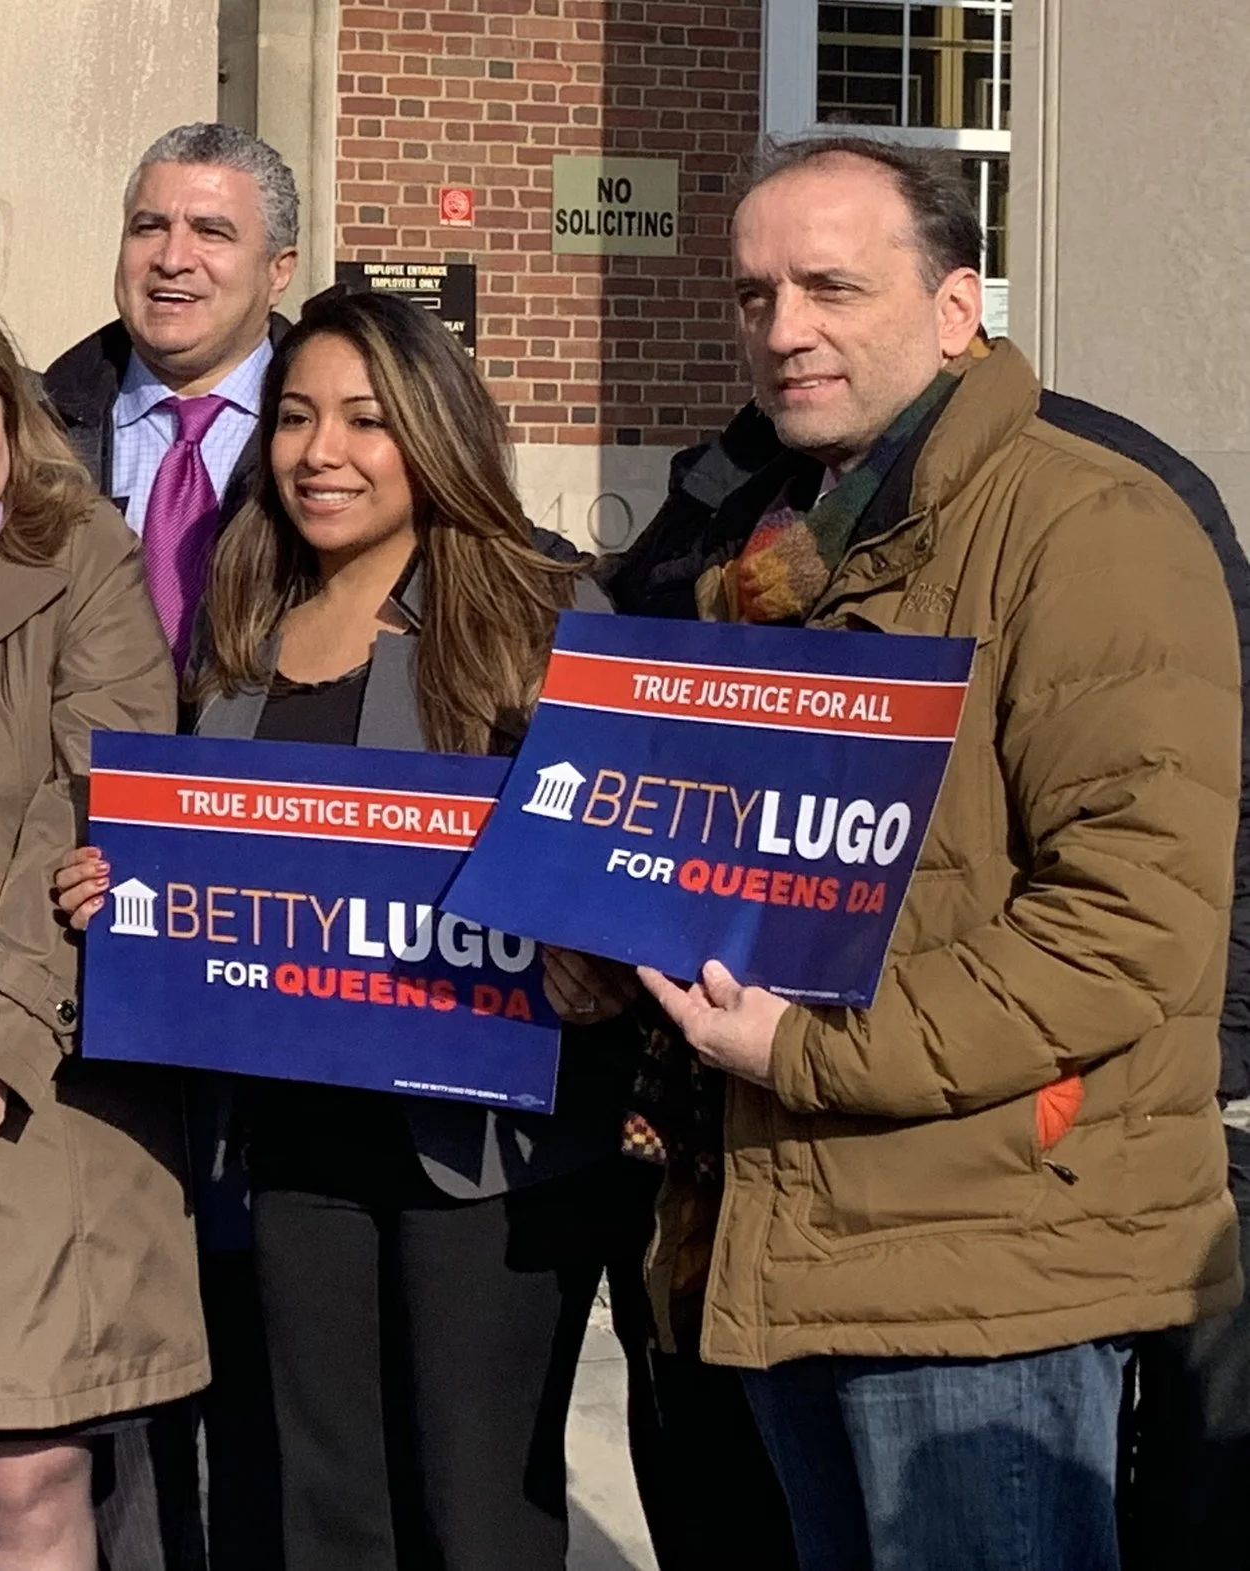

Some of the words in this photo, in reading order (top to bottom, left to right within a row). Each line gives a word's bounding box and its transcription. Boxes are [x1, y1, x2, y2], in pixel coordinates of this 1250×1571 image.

[597, 178, 632, 204] NO
[555, 209, 674, 238] SOLICITING
[364, 264, 405, 277] EMPLOYEE
[406, 265, 448, 278] ENTRANCE
[371, 276, 417, 290] EMPLOYEES
[419, 278, 441, 290] ONLY
[631, 674, 694, 702] TRUE
[695, 679, 793, 714] JUSTICE
[796, 689, 846, 719] FOR
[849, 695, 893, 723] ALL
[176, 788, 247, 819] TRUE
[251, 796, 359, 827] JUSTICE
[366, 803, 423, 833] FOR
[426, 809, 478, 837] ALL
[606, 848, 676, 884] FOR
[678, 857, 840, 912] QUEENS
[846, 881, 887, 915] DA
[206, 959, 269, 990] FOR
[274, 962, 458, 1012] QUEENS
[472, 984, 533, 1022] DA
